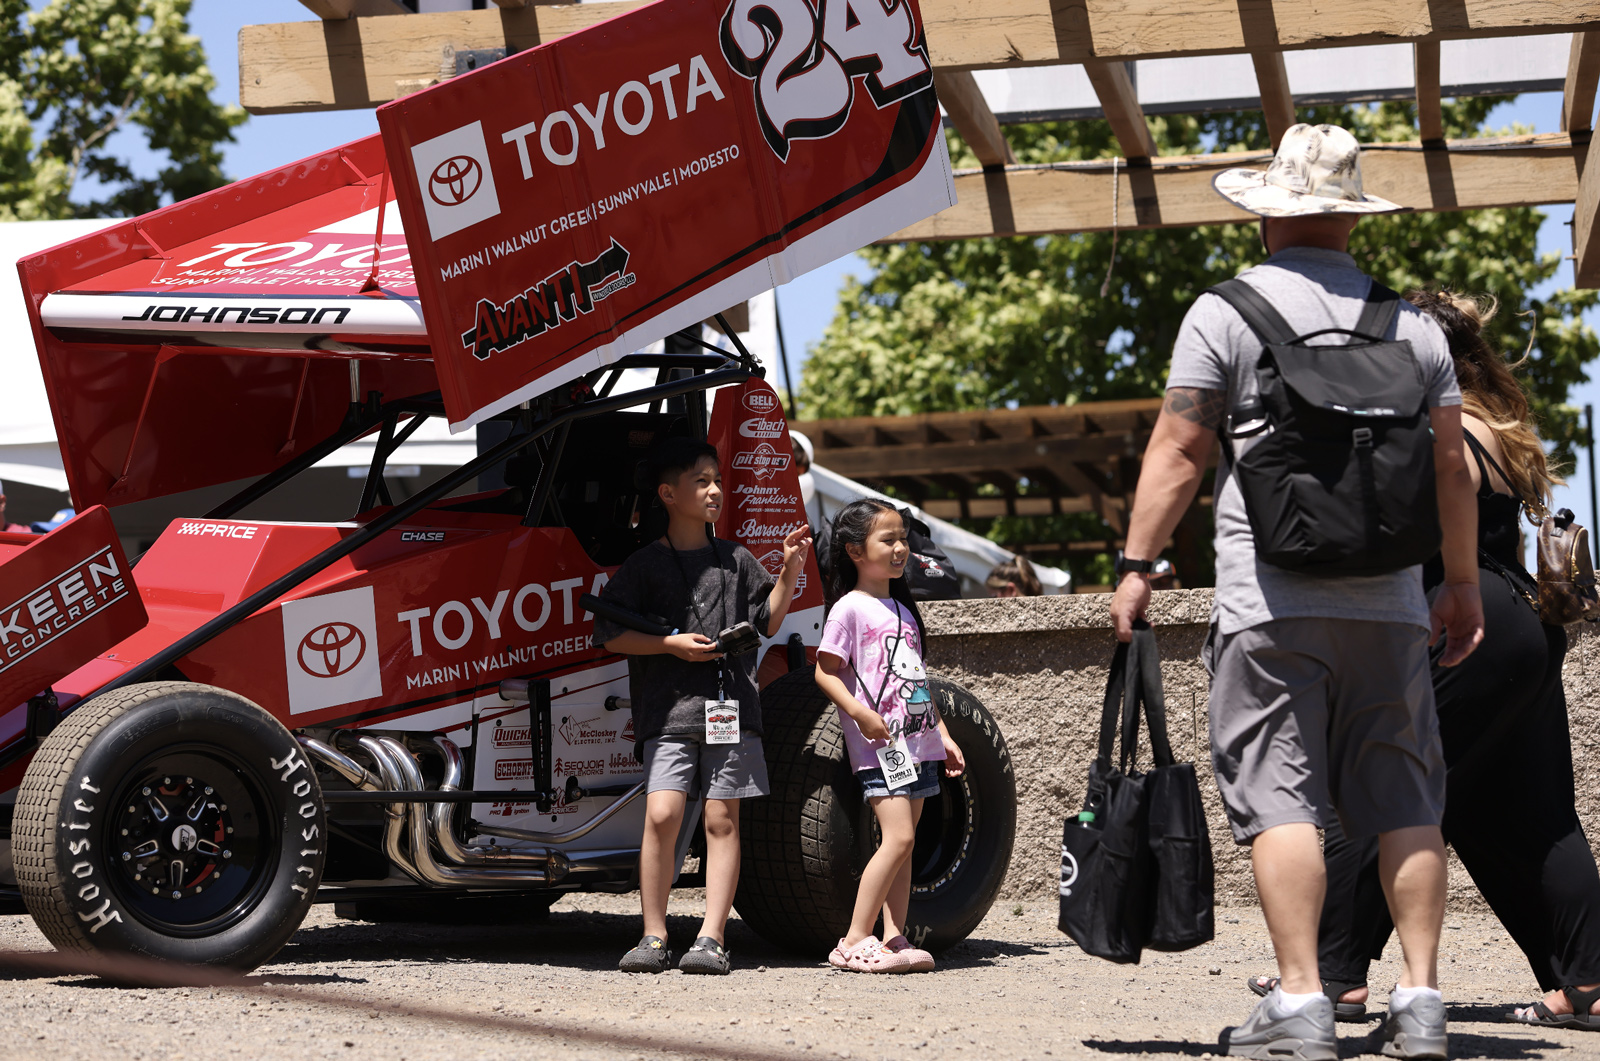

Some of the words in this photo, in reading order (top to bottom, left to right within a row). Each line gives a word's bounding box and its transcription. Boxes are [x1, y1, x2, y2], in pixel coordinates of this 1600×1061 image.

[720, 0, 933, 163] 24
[501, 54, 725, 181] TOYOTA
[440, 252, 484, 282] MARIN
[491, 224, 547, 260] WALNUT
[550, 206, 597, 236] CREEK
[598, 171, 672, 216] SUNNYVALE
[679, 144, 740, 181] MODESTO
[176, 241, 413, 269] TOYO
[154, 277, 282, 286] SUNNYVALE
[176, 268, 252, 276] MARIN
[272, 268, 358, 276] WALNUT
[363, 269, 416, 279] CREE
[122, 305, 351, 324] JOHNSON
[474, 263, 585, 352] AVANTI
[749, 395, 774, 406] BELL
[739, 418, 785, 438] Eibach
[736, 454, 754, 466] pit
[754, 457, 770, 467] stop
[732, 485, 780, 495] Johnny
[738, 495, 798, 509] Franklin's
[402, 532, 445, 541] CHASE
[736, 519, 804, 538] Barsotti'
[6, 577, 126, 658] CONCRETE
[406, 664, 460, 690] MARIN
[472, 645, 538, 673] WALNUT
[541, 634, 594, 659] CREEK
[580, 730, 617, 738] McCloskey
[889, 714, 923, 741] Hello
[497, 762, 534, 777] SCHOENF
[564, 760, 605, 771] SEQUOIA
[885, 749, 905, 772] 50
[564, 768, 604, 777] RIFLEWORKS
[889, 769, 905, 780] TURN
[271, 746, 325, 902] Hoosier
[61, 775, 124, 934] Hoosier
